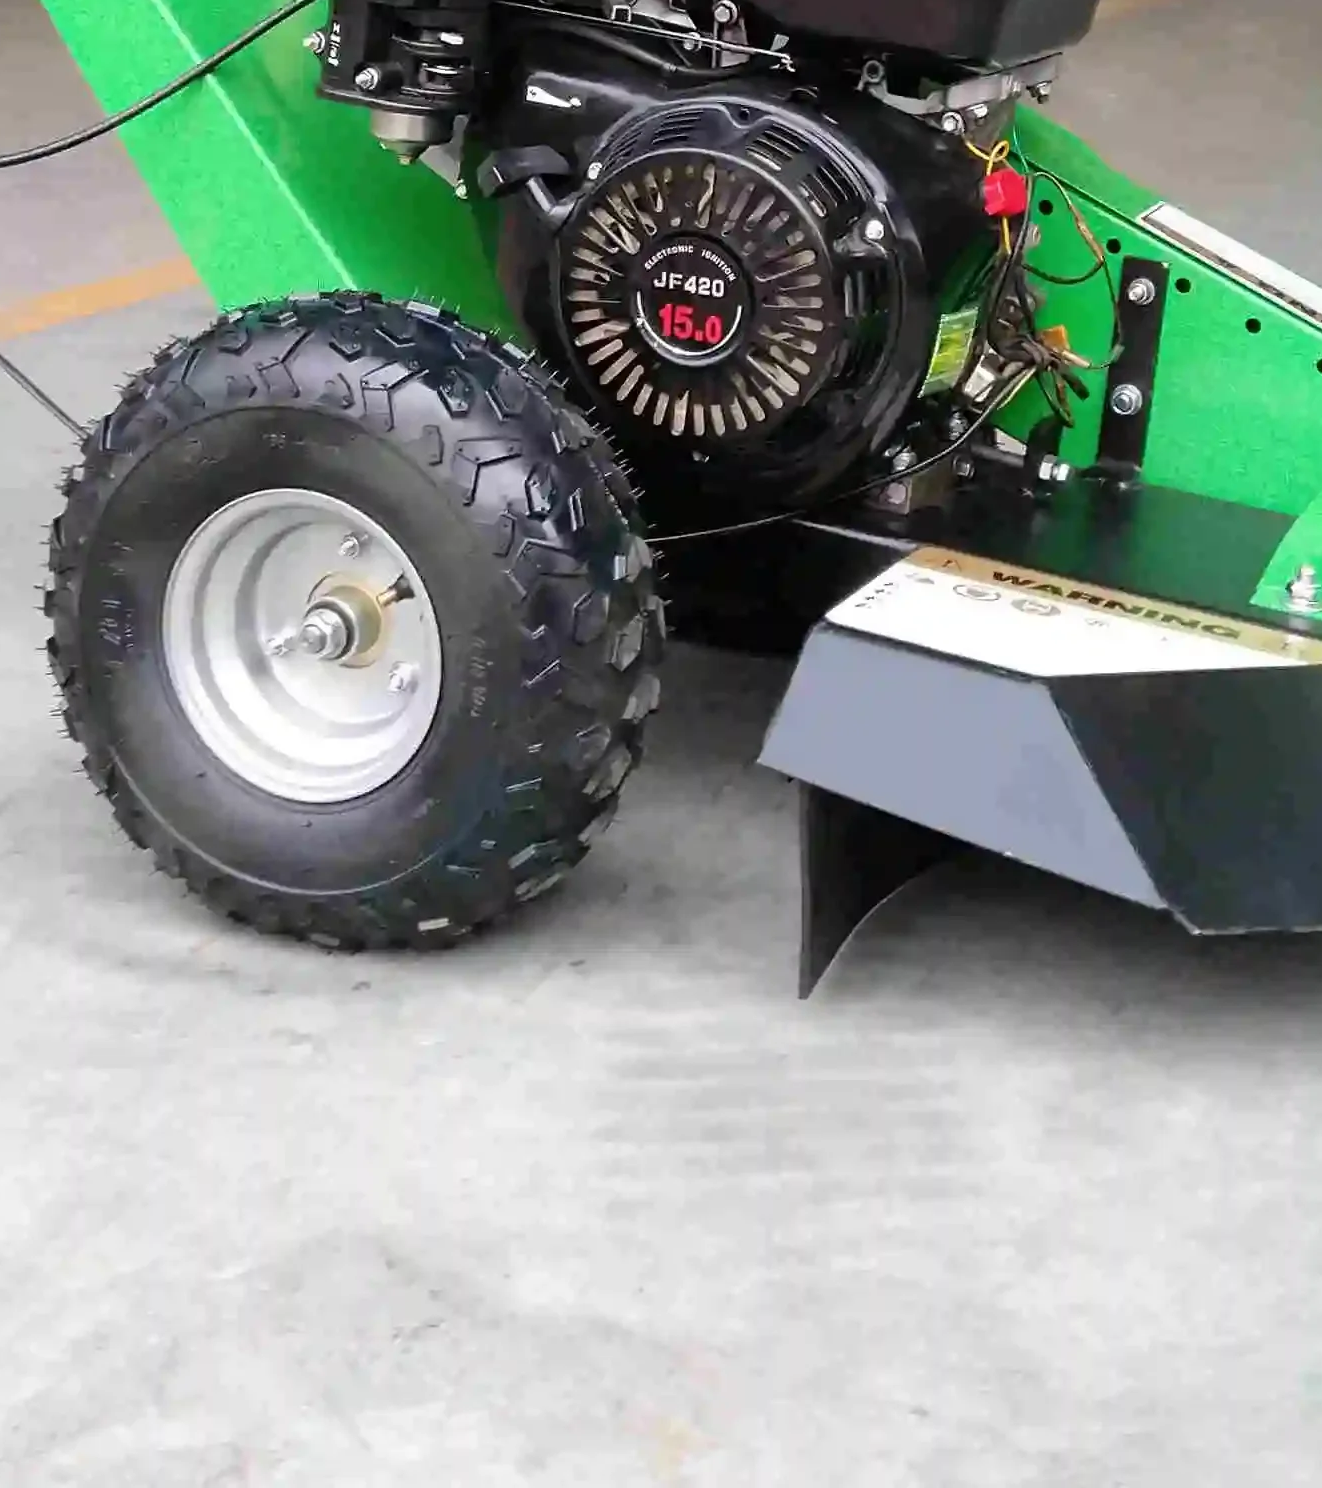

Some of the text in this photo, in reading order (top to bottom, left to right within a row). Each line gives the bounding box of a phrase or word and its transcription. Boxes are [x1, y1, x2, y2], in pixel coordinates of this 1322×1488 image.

[644, 244, 737, 282] ELECTRONIC IGNITION
[653, 272, 725, 298] JF420
[658, 303, 722, 344] 15.0
[992, 570, 1242, 640] WARNING
